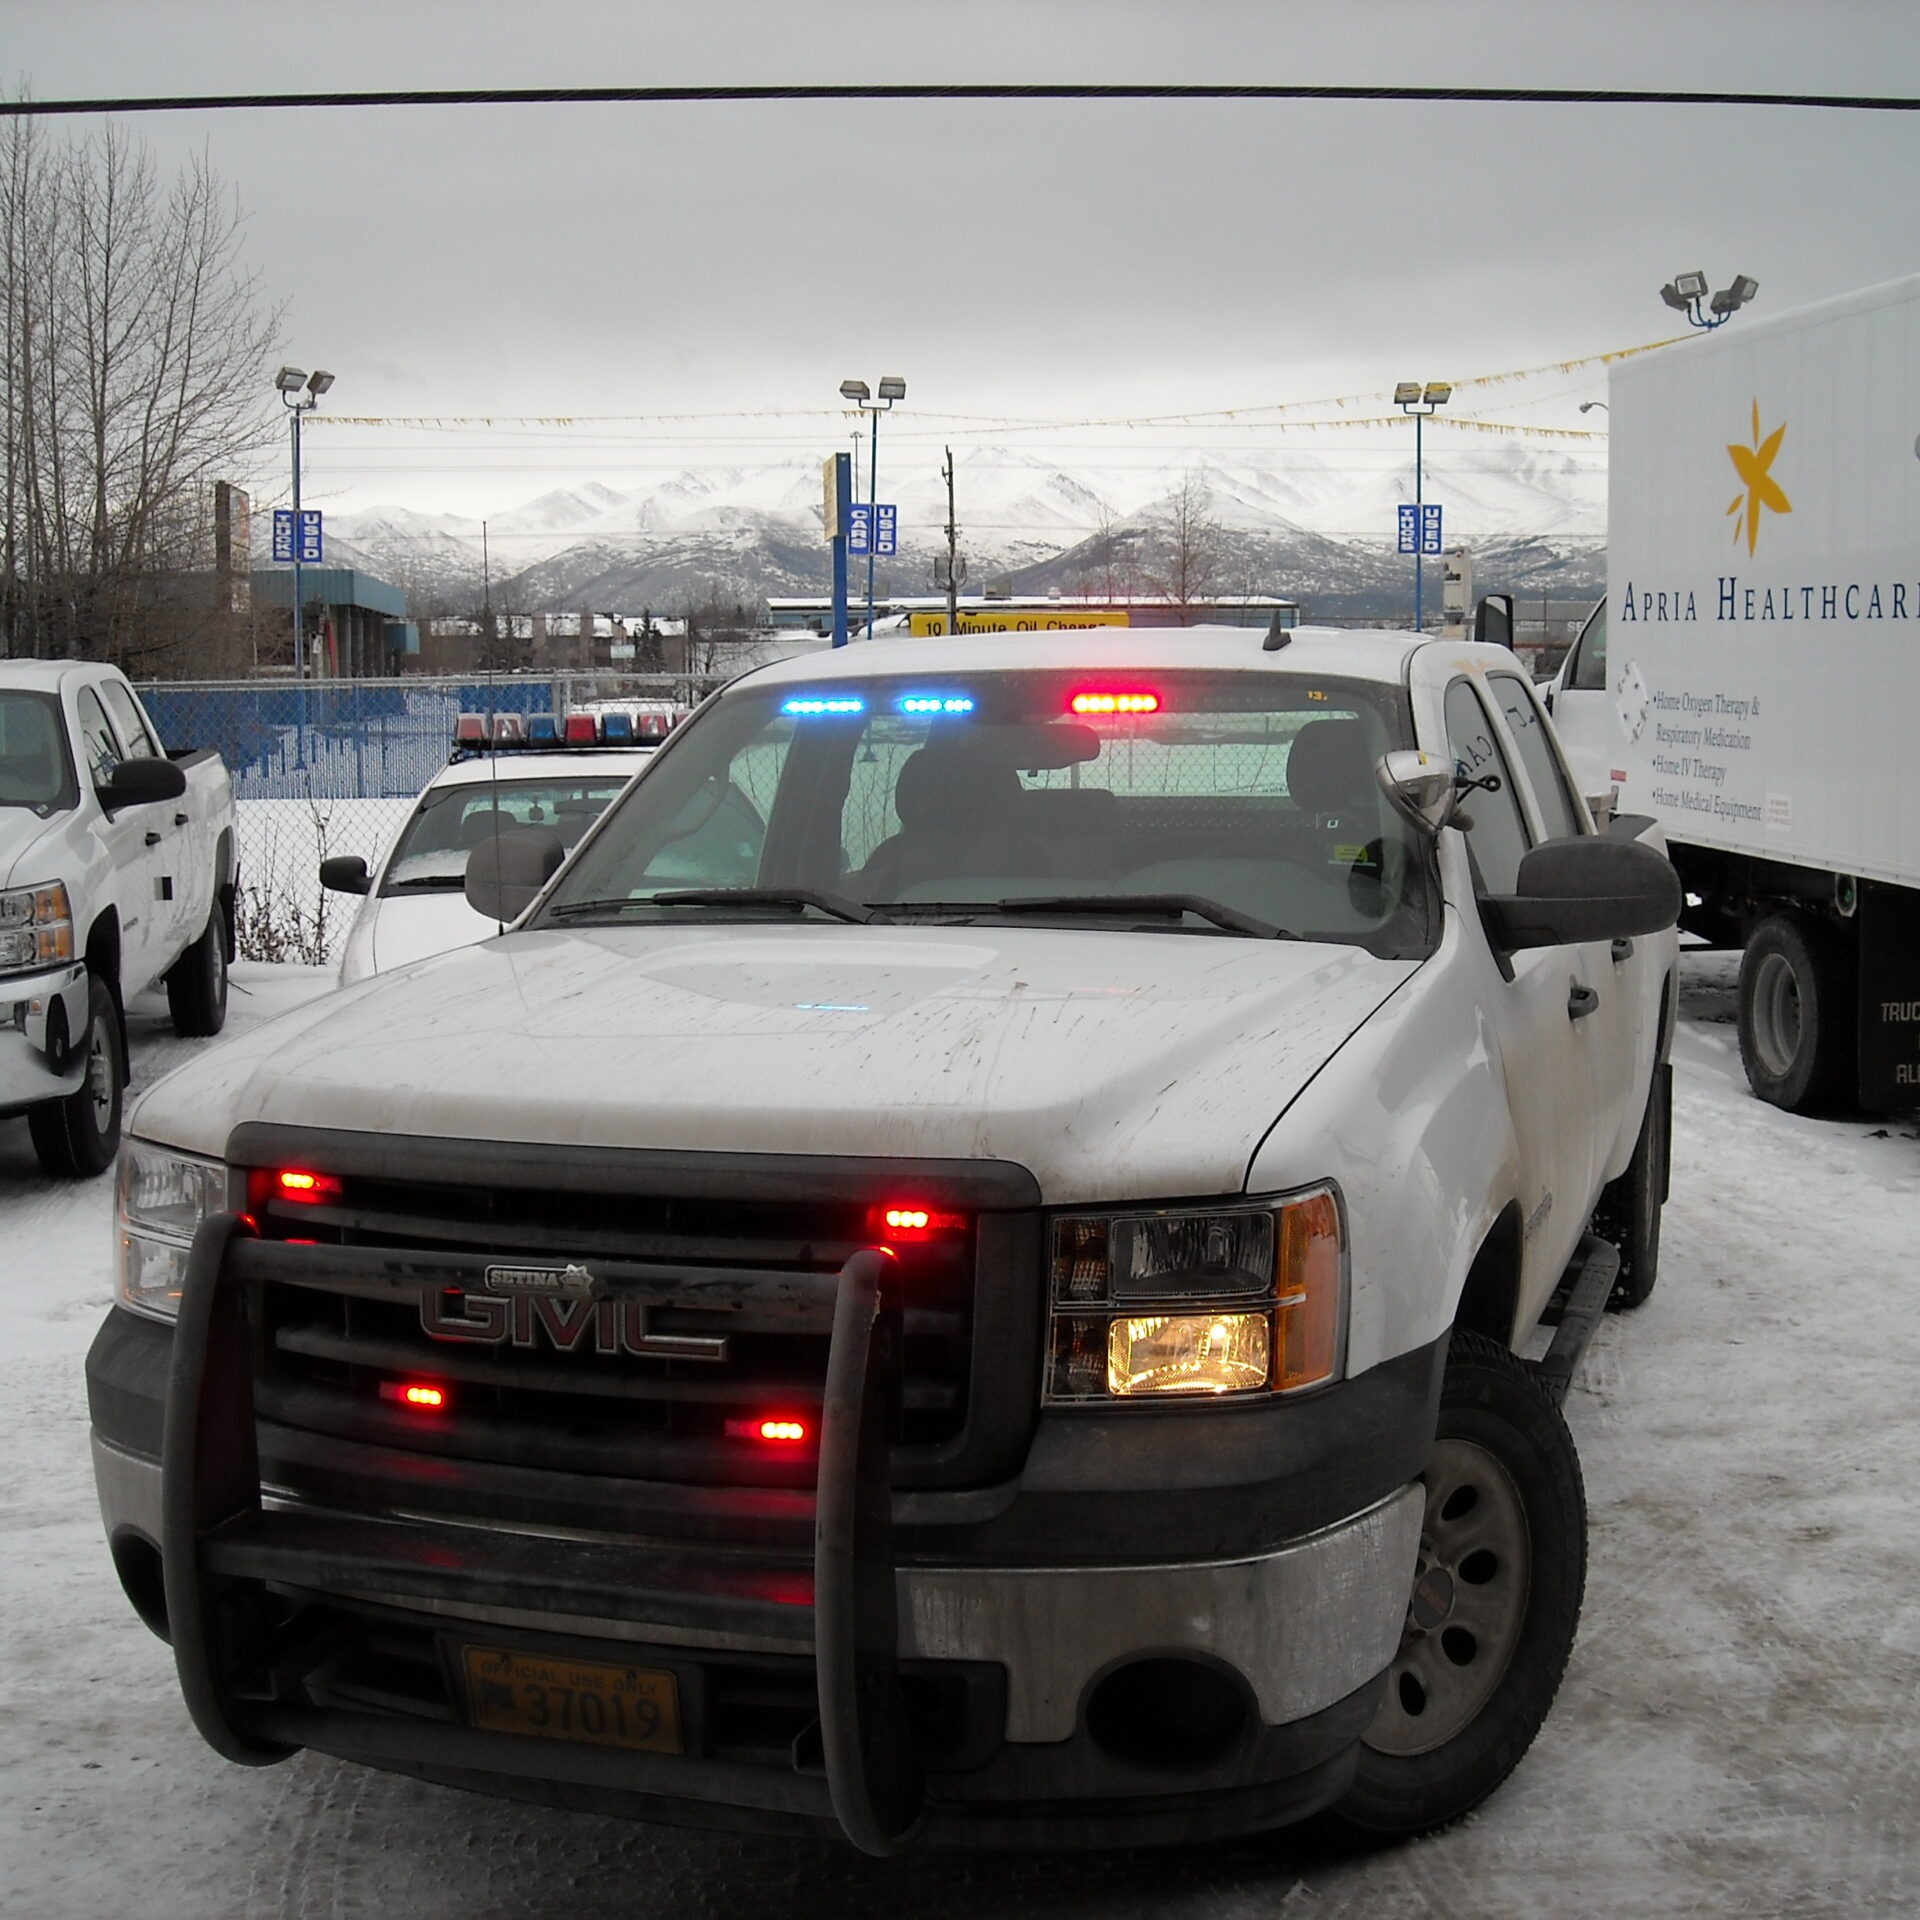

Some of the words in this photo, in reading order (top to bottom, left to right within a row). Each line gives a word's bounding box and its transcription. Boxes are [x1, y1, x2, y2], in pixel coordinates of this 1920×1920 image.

[303, 514, 320, 558] USED
[851, 510, 868, 548] CARS
[878, 508, 894, 552] USED
[1400, 509, 1415, 551] TRUCKS
[1424, 508, 1440, 551] USED
[1622, 581, 1697, 621] APRIA
[926, 622, 942, 636] 10
[956, 621, 1007, 635] Minute
[1016, 620, 1037, 632] Oil
[1046, 620, 1106, 631] Chan
[1656, 691, 1680, 711] Home
[1682, 692, 1713, 718] Oxygen
[1715, 694, 1750, 720] Therapy
[1752, 696, 1760, 715] &
[1656, 723, 1702, 750] Respiratory
[1704, 727, 1751, 750] Medication
[1656, 754, 1680, 776] Home
[1681, 758, 1692, 776] IV
[1693, 759, 1727, 786] Therapy
[1656, 787, 1679, 807] Home
[1681, 791, 1712, 812] Medical
[1714, 795, 1762, 823] Equipment
[1896, 1064, 1920, 1084] AL
[491, 1269, 559, 1288] SETINA
[420, 1288, 730, 1362] GMC
[481, 1660, 559, 1684] OFFICIAL
[569, 1672, 604, 1689] USE
[613, 1677, 658, 1695] ONLY
[522, 1684, 662, 1742] 37019
